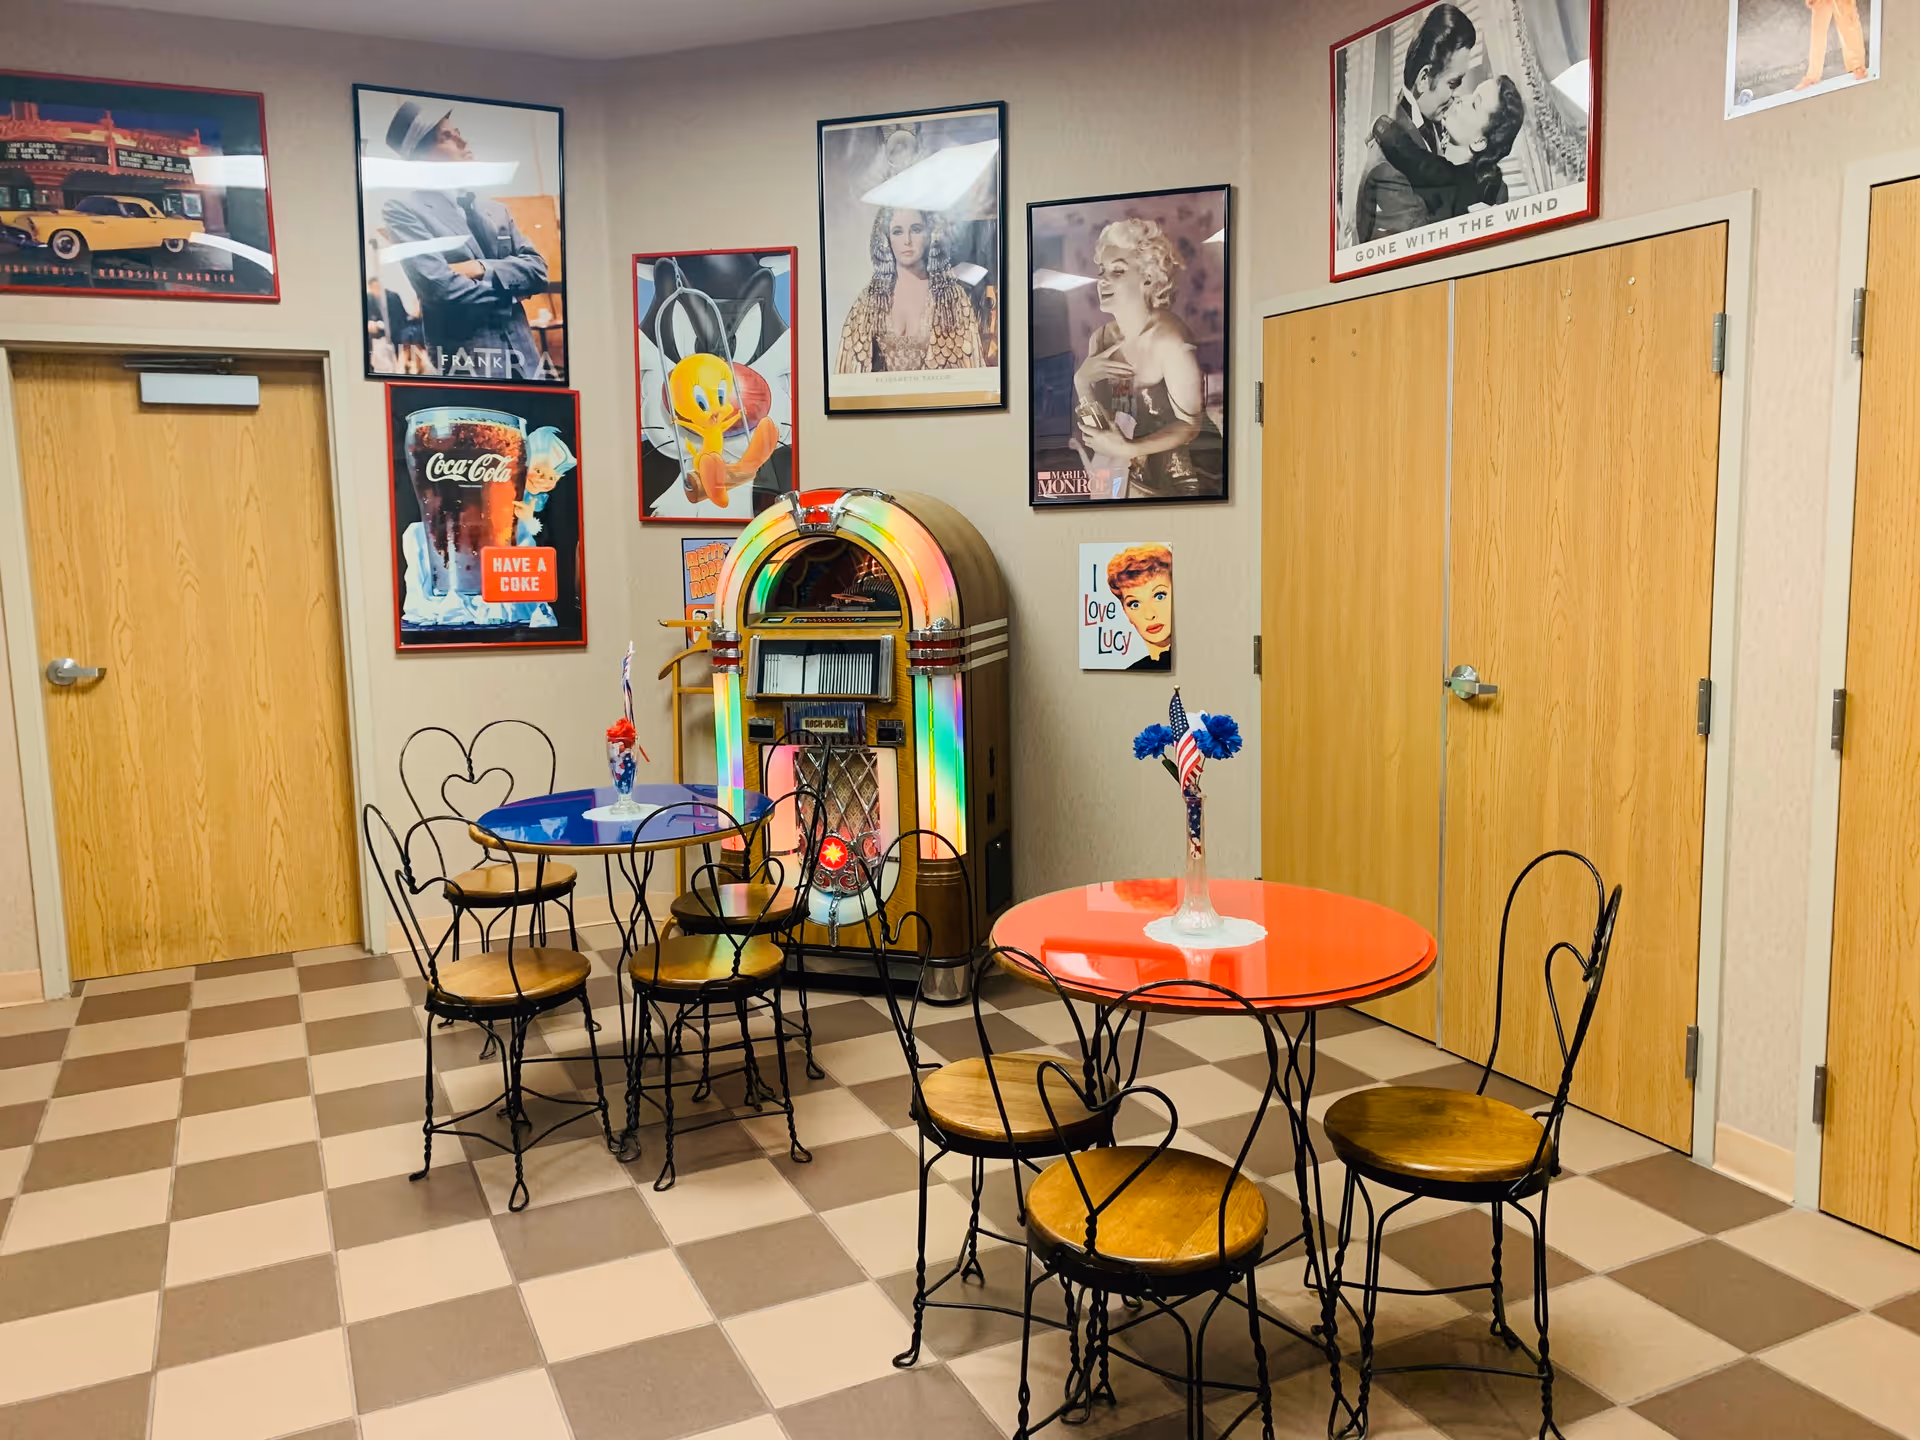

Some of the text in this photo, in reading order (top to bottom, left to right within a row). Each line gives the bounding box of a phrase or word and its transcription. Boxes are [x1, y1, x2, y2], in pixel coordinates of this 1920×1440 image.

[1356, 198, 1559, 263] GONE WITH THE WIND
[177, 271, 235, 284] AMERICA
[441, 354, 503, 369] FRANK
[425, 452, 512, 483] Coca-Cola
[492, 557, 547, 573] HAVE A
[500, 576, 540, 592] COKE
[1093, 563, 1098, 593] I
[1084, 593, 1117, 627] Love
